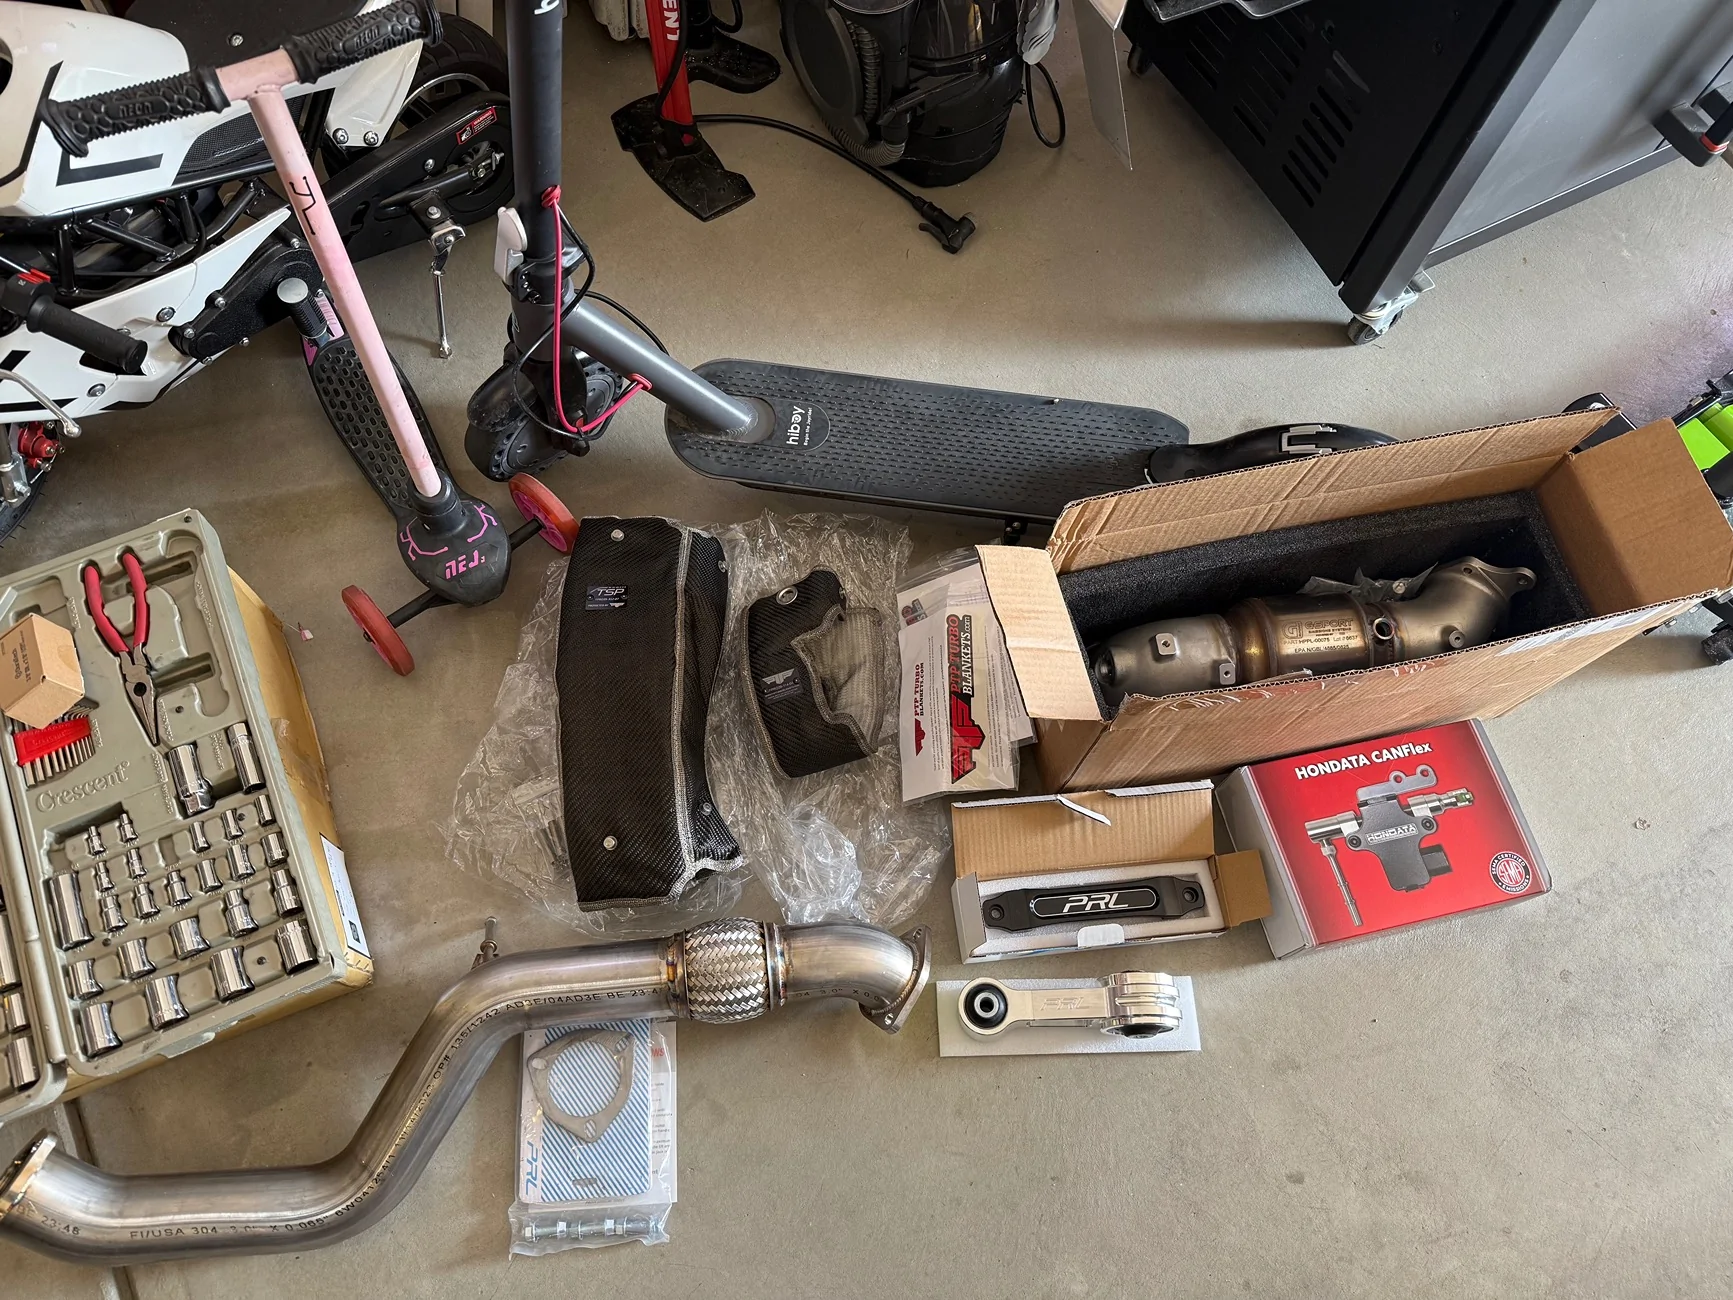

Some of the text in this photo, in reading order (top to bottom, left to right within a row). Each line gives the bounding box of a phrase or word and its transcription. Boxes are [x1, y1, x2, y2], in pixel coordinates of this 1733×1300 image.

[785, 405, 806, 445] hiboy
[597, 588, 625, 597] TSP
[1304, 618, 1354, 630] GSPORT
[948, 615, 961, 694] PTP TURBO
[960, 616, 974, 696] BLANKETS.com
[1294, 742, 1433, 780] HONDATA CANFlex
[1366, 823, 1416, 842] HONDATA
[1491, 853, 1526, 875] SEMA CERTIFIED
[1499, 860, 1524, 885] SEMA
[1502, 878, 1529, 892] EMISSIONS
[1062, 893, 1129, 913] PRL
[1040, 996, 1092, 1011] PRL
[129, 1227, 185, 1239] FI/USA
[191, 1226, 218, 1235] 304
[450, 1008, 501, 1050] 135/1242
[606, 991, 626, 1000] BE
[525, 1140, 539, 1196] PRL
